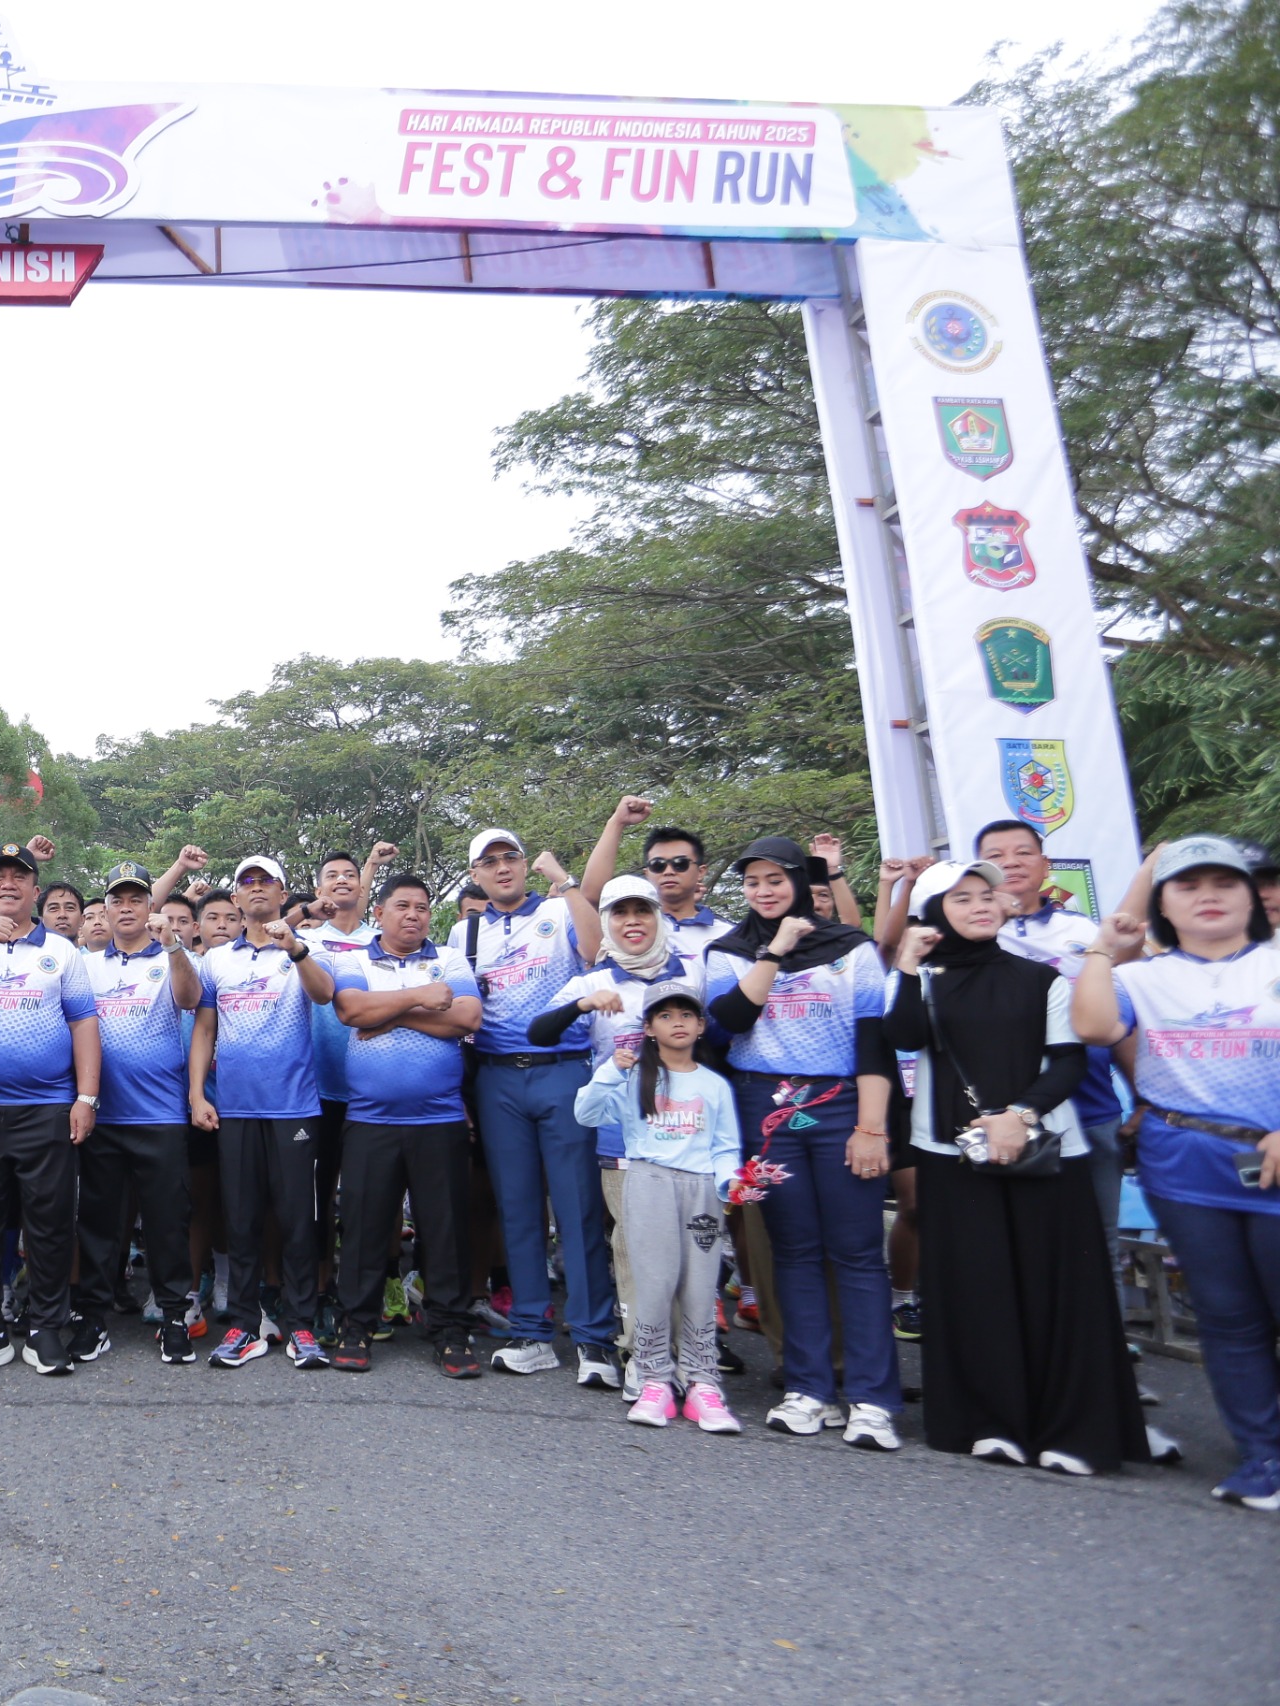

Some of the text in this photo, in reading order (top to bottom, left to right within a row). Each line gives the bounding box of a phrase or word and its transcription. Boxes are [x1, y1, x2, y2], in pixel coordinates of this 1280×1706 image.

[406, 114, 809, 143] HARI ARMADA REPUBLIK INDONESIA TAHUN 2025
[399, 142, 814, 206] FEST & FUN RUN
[1006, 742, 1029, 750] BATU
[1052, 862, 1084, 870] BEDAGAI
[527, 965, 548, 981] RUN
[20, 998, 41, 1010] RUN
[100, 1005, 149, 1017] & FUN RUN
[233, 1000, 240, 1012] &
[242, 1000, 260, 1012] FUN
[766, 1002, 832, 1019] & FUN RUN
[1148, 1039, 1184, 1058] FEST
[1189, 1041, 1204, 1058] &
[1211, 1040, 1247, 1058] FUN
